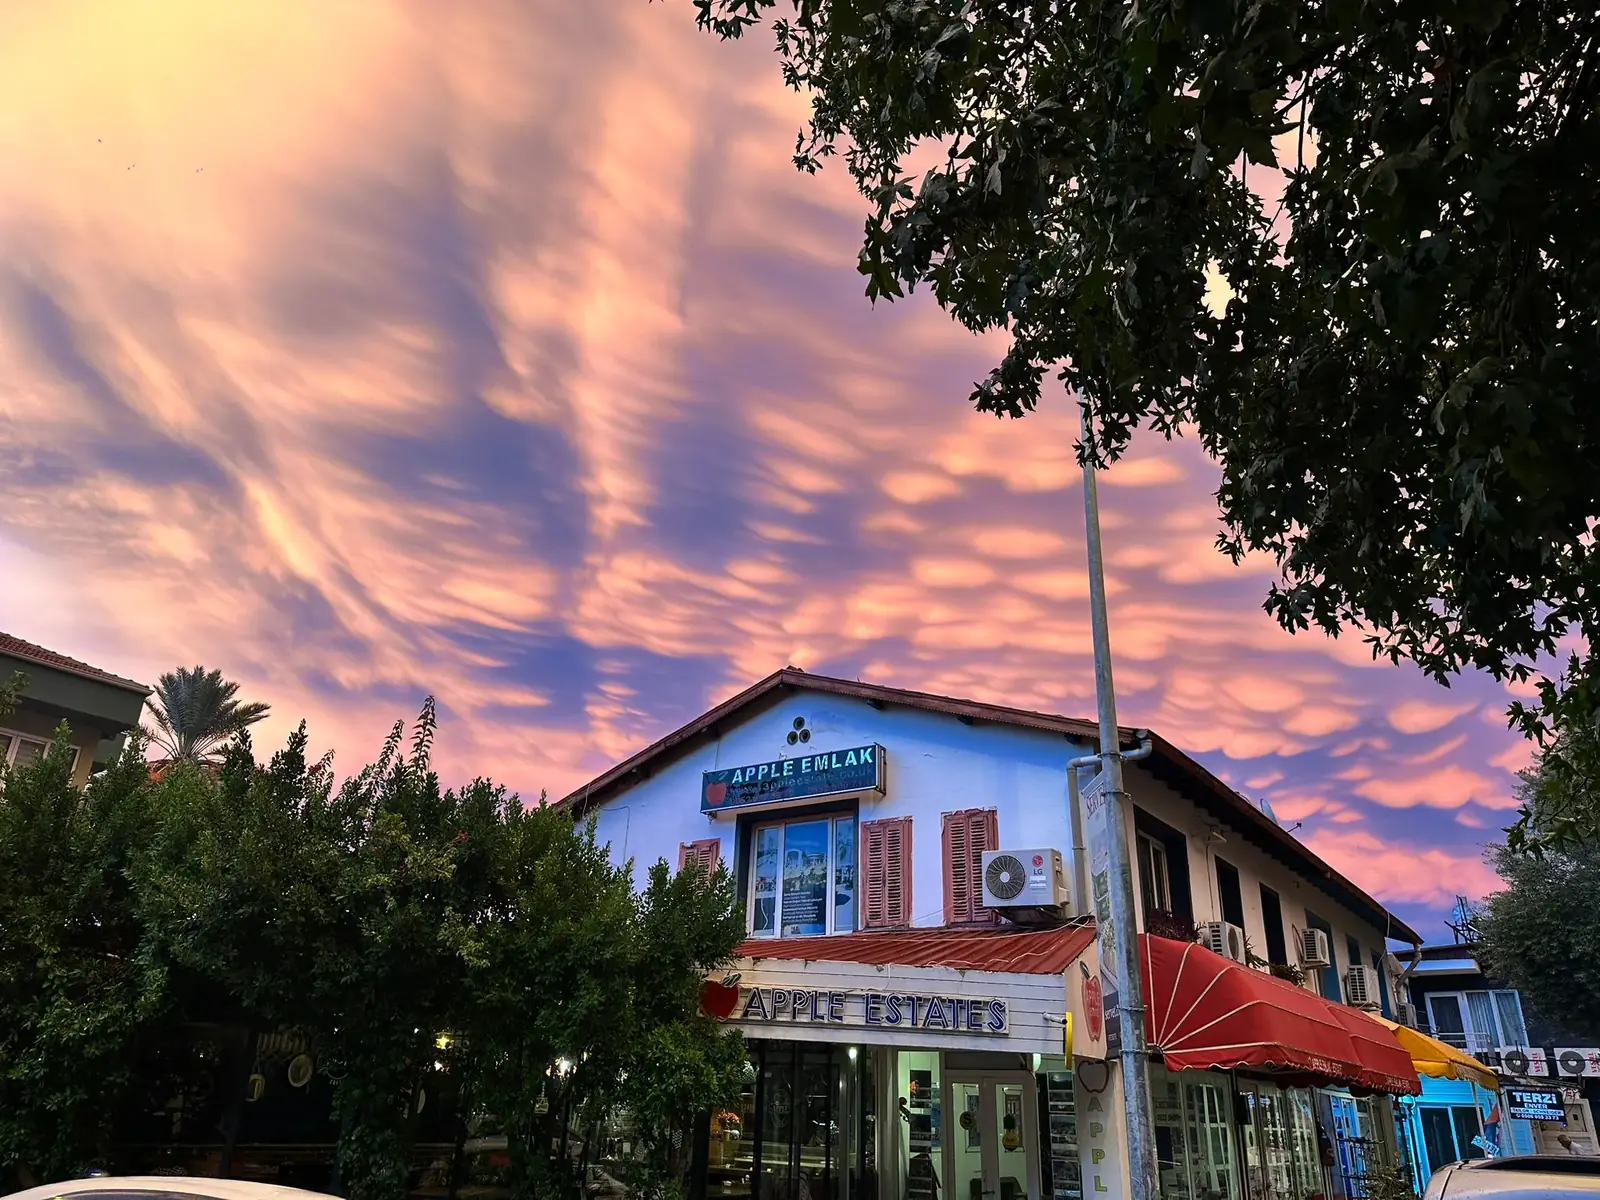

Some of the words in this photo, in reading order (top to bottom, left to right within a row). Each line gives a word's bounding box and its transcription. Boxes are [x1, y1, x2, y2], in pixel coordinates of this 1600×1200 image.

[731, 761, 794, 784] APPLE
[801, 747, 873, 774] EMLAK
[1033, 868, 1043, 876] LG
[742, 986, 846, 1022] APPLE
[864, 992, 1007, 1032] ESTATES
